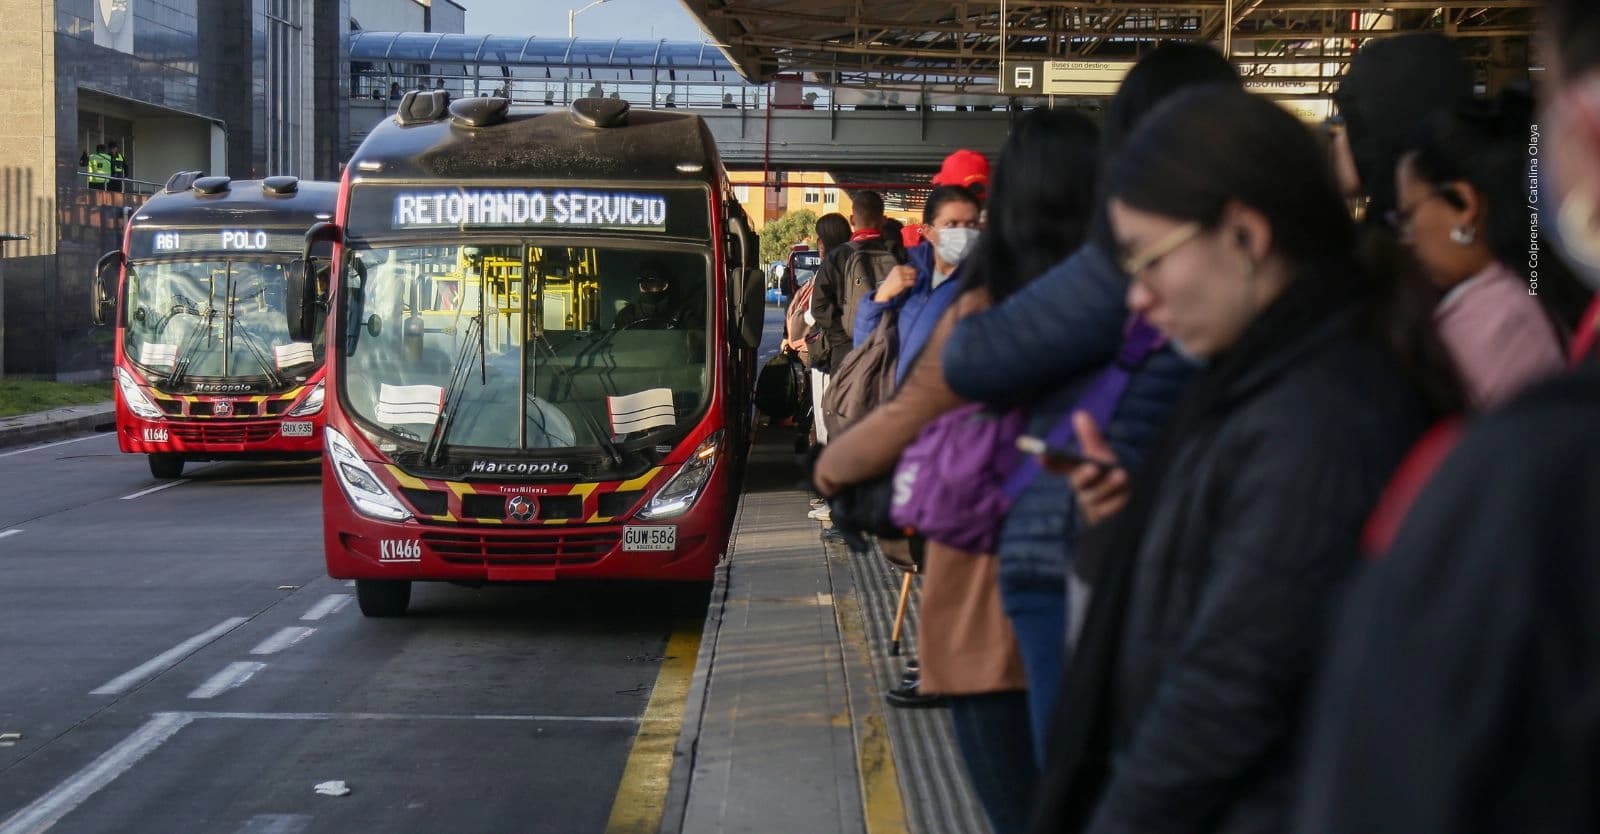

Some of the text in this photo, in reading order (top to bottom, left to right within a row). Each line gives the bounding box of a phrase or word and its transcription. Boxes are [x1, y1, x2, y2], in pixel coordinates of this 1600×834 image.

[399, 192, 666, 226] RETOMANDO SERVICIO
[157, 232, 267, 249] A61 POLO
[195, 383, 252, 392] Marcopolo
[144, 428, 169, 441] K1646
[282, 423, 297, 433] GUX
[471, 460, 569, 474] Marcopolo
[500, 486, 548, 494] TransMilenio
[625, 530, 674, 544] GUW 586
[380, 540, 421, 559] K1466
